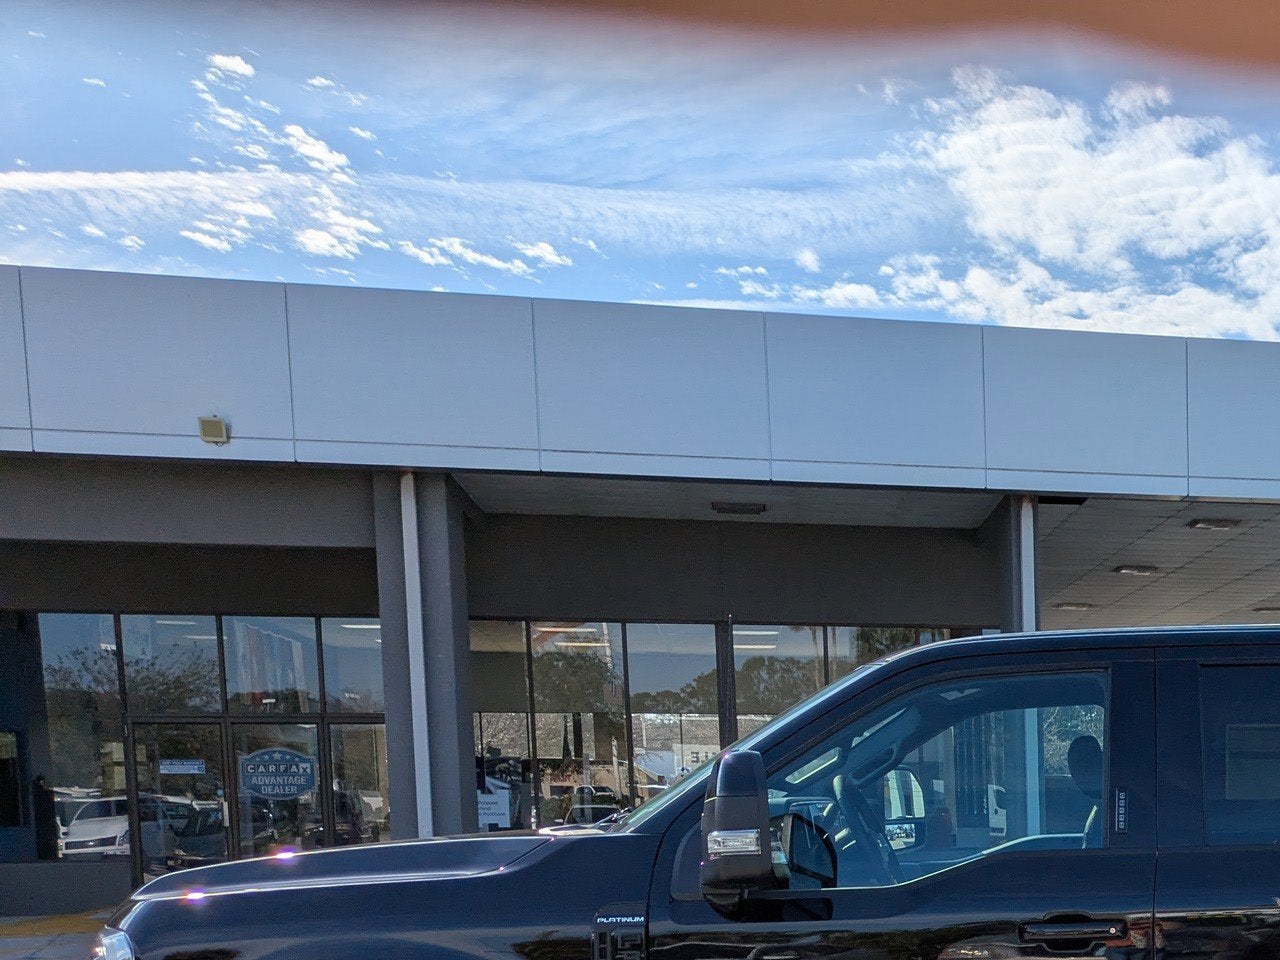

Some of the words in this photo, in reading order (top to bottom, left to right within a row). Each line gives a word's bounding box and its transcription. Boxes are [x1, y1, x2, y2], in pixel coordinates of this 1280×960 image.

[247, 763, 311, 774] CARFAX
[251, 776, 307, 785] ADVANTAGE
[261, 786, 298, 795] DEALER
